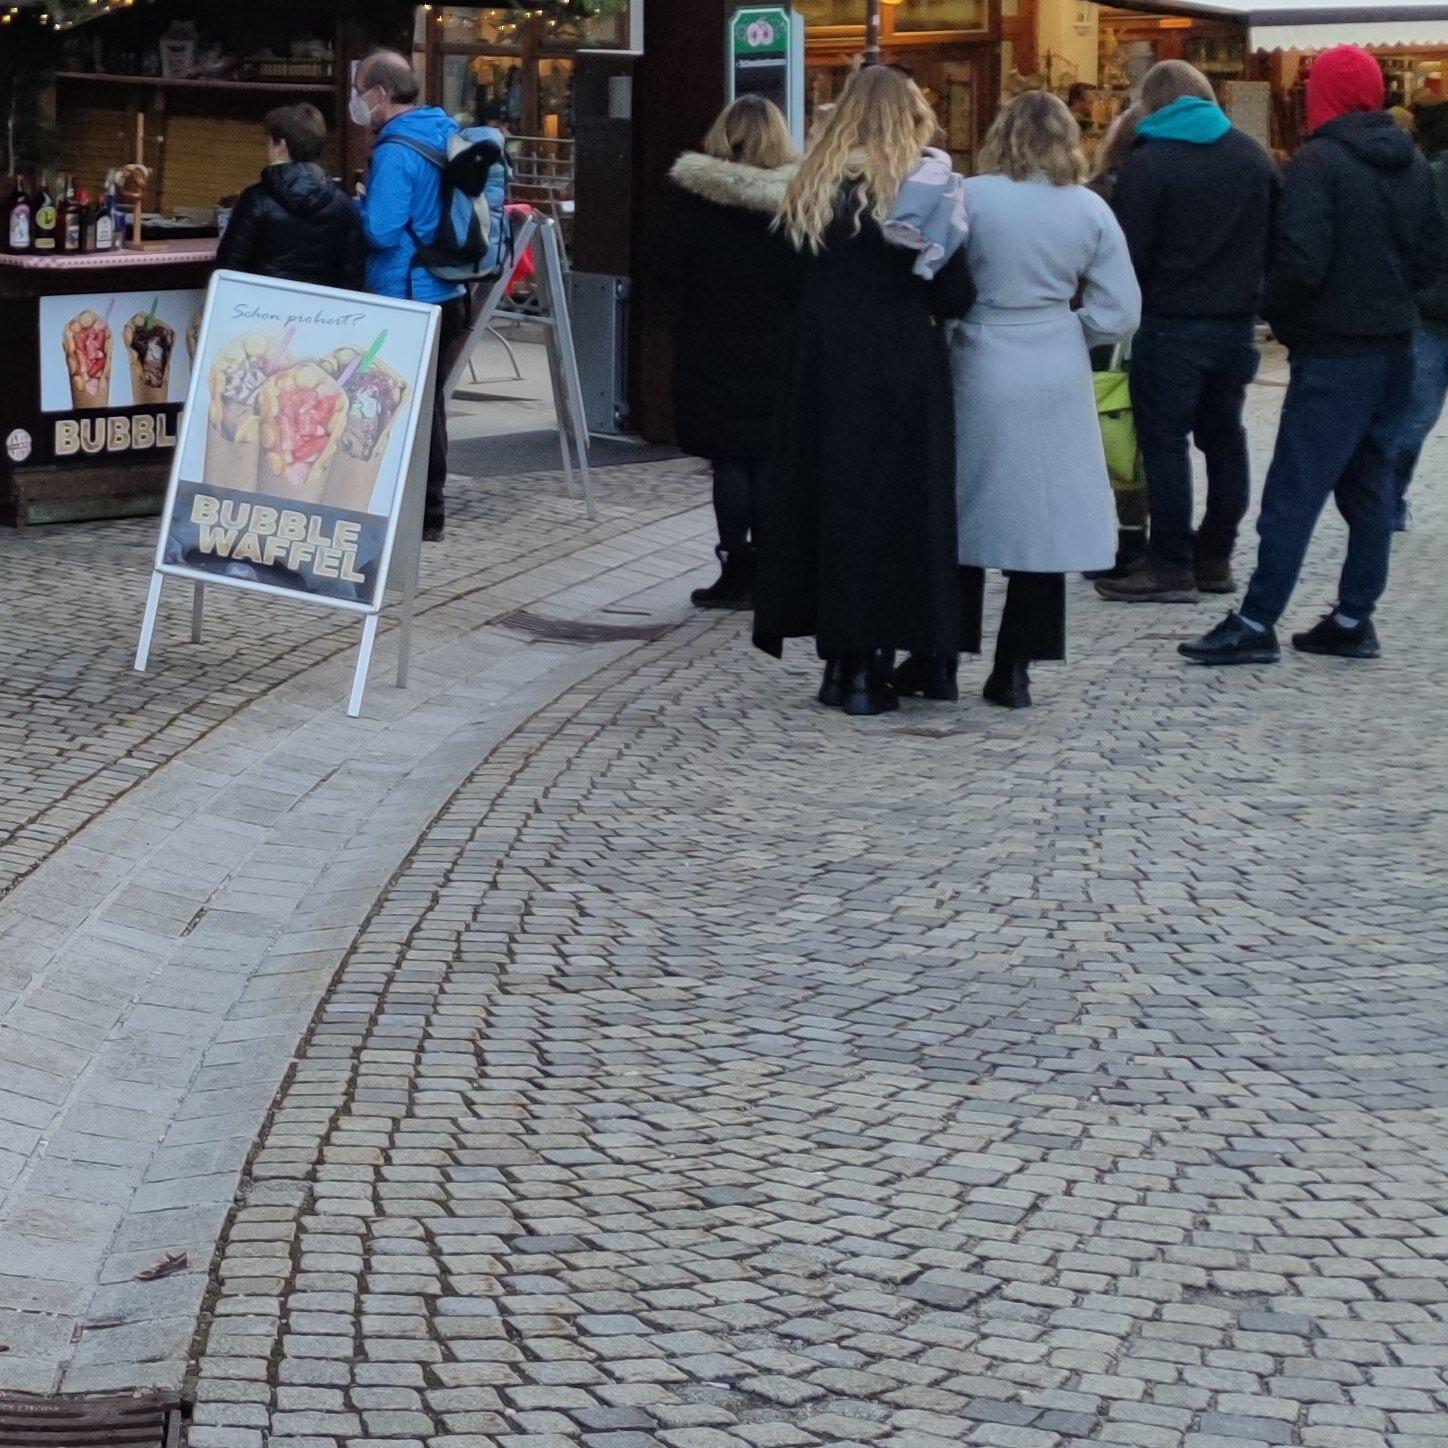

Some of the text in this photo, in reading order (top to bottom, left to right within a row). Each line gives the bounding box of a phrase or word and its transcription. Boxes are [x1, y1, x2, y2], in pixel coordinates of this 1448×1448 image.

[231, 303, 280, 321] Schon
[54, 412, 183, 456] BUBBL
[190, 493, 362, 553] BUBBLE
[199, 523, 366, 585] WAFFEL
